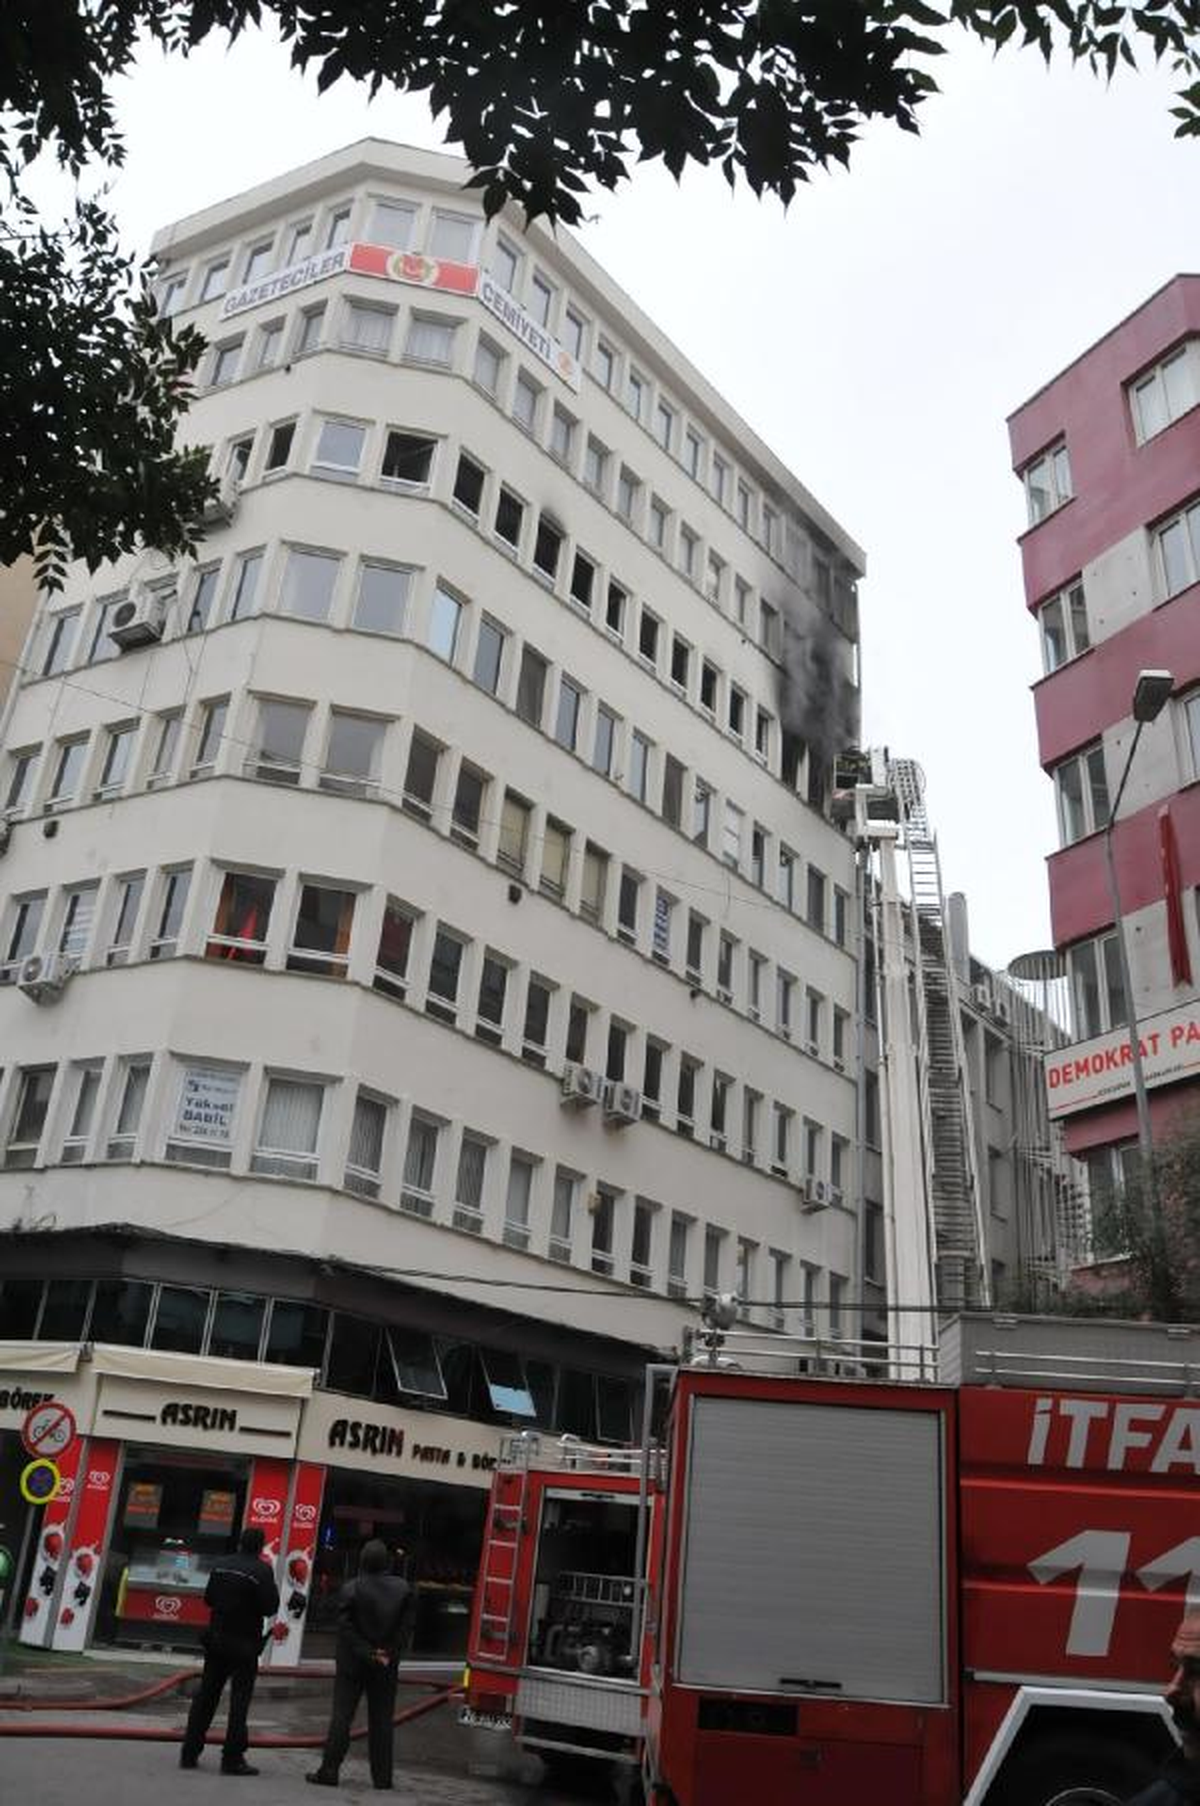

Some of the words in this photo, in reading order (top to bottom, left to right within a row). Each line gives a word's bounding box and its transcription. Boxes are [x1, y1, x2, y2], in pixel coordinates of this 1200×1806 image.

[224, 250, 345, 314] GAZETECİLER
[482, 281, 552, 361] CEMİYETİ
[1048, 1032, 1160, 1089] DEMOKRAT
[161, 1402, 238, 1432] ASRIN
[328, 1418, 405, 1458] ASRIN
[412, 1443, 451, 1465] PASTA
[1027, 1397, 1200, 1475] İTFA
